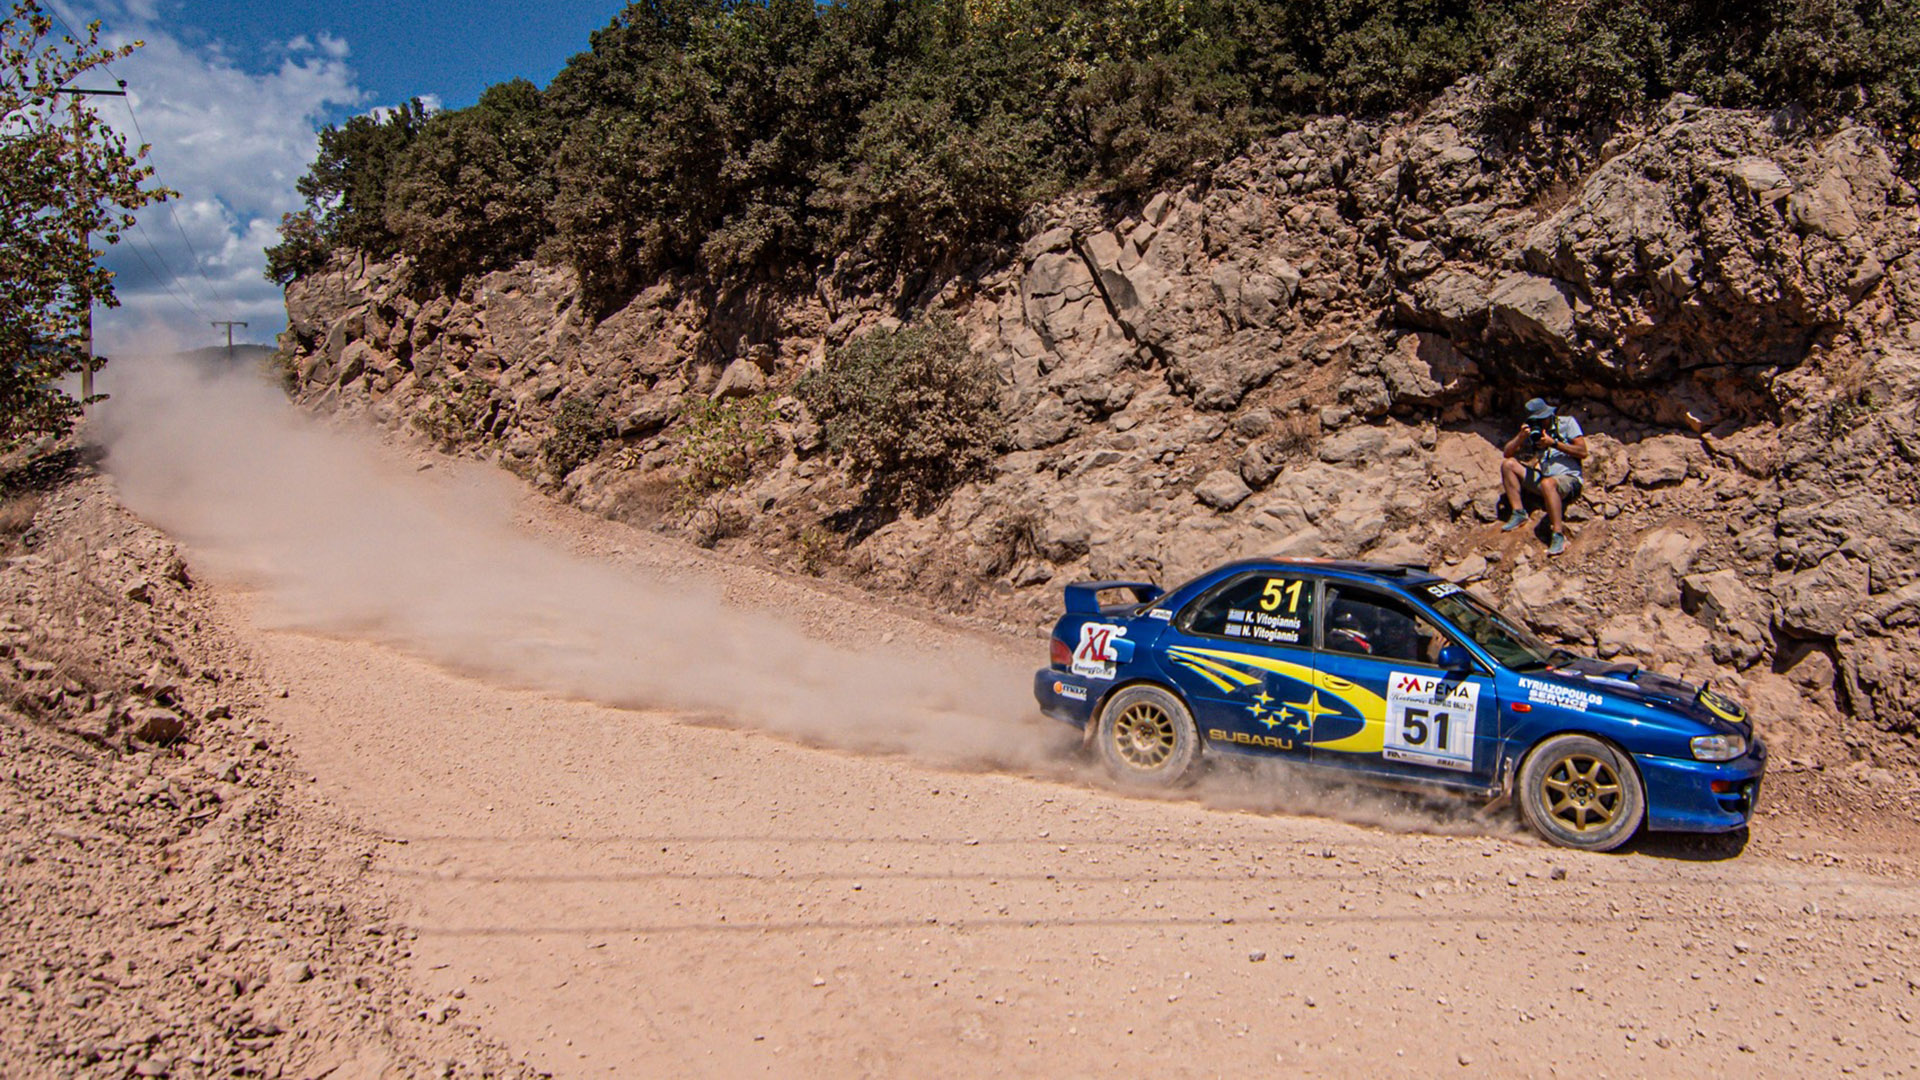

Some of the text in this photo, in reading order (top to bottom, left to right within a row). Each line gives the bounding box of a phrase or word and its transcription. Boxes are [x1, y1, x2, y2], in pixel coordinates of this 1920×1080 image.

[1260, 578, 1303, 613] 51
[1245, 610, 1301, 629] K. Vitogiannis
[1079, 627, 1111, 661] XL
[1242, 624, 1299, 642] N. Vitogiannis
[1424, 681, 1469, 698] PEMA
[1518, 677, 1603, 705] KYRIAZOPOULOS
[1529, 689, 1589, 709] SERVICE
[1209, 728, 1293, 750] SUBARU
[1402, 707, 1449, 750] 51
